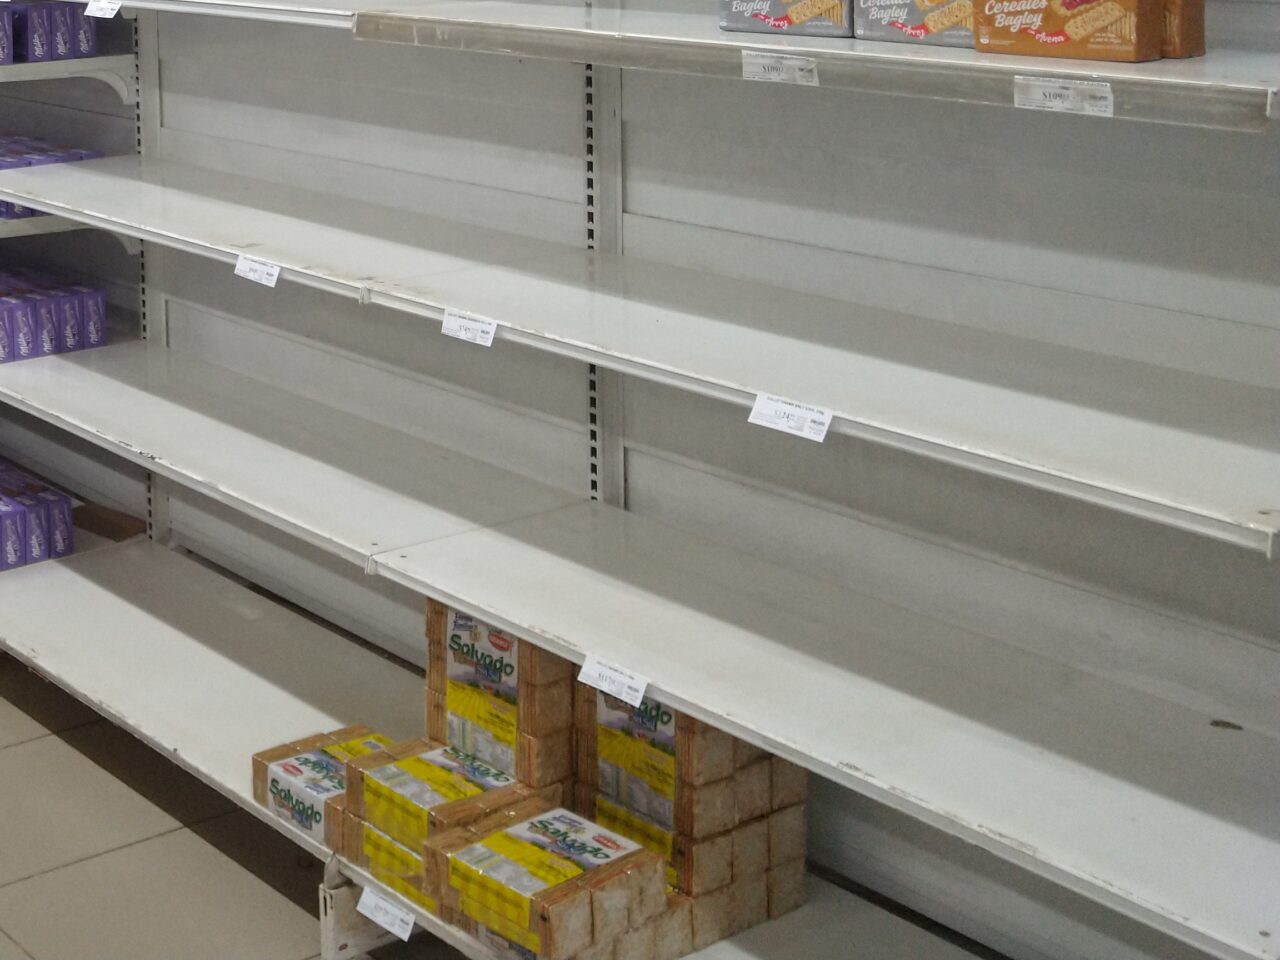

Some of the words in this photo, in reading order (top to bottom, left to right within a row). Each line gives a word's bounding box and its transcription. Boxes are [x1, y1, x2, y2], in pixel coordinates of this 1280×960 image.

[732, 0, 771, 17] Bagley
[868, 6, 908, 24] Bagley
[994, 12, 1043, 32] Bagley
[449, 633, 515, 677] Salvado
[269, 778, 322, 824] Salvado
